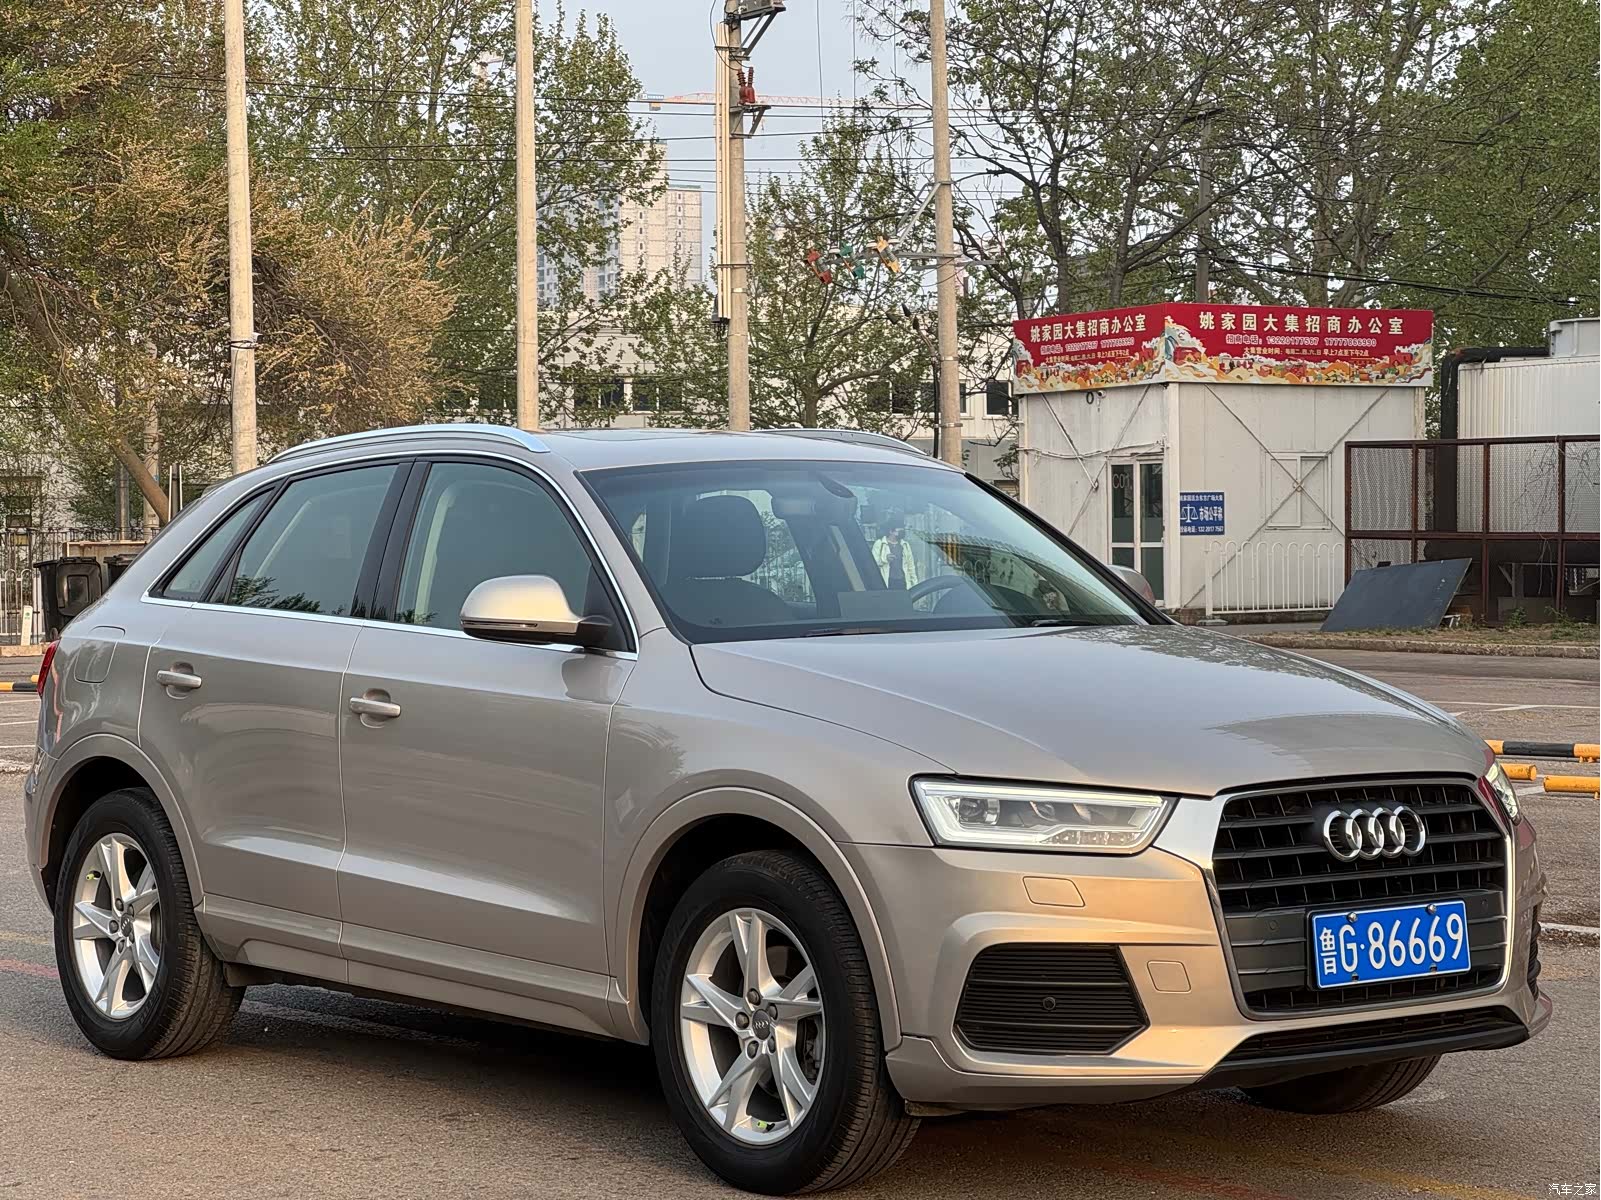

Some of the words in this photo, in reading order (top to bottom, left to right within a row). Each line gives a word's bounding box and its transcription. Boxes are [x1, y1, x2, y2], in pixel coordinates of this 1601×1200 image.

[1030, 313, 1146, 342] 姚家园大集招商办公室
[1199, 311, 1403, 334] 姚家园大集招商办公室
[1324, 338, 1377, 347] 17777866990
